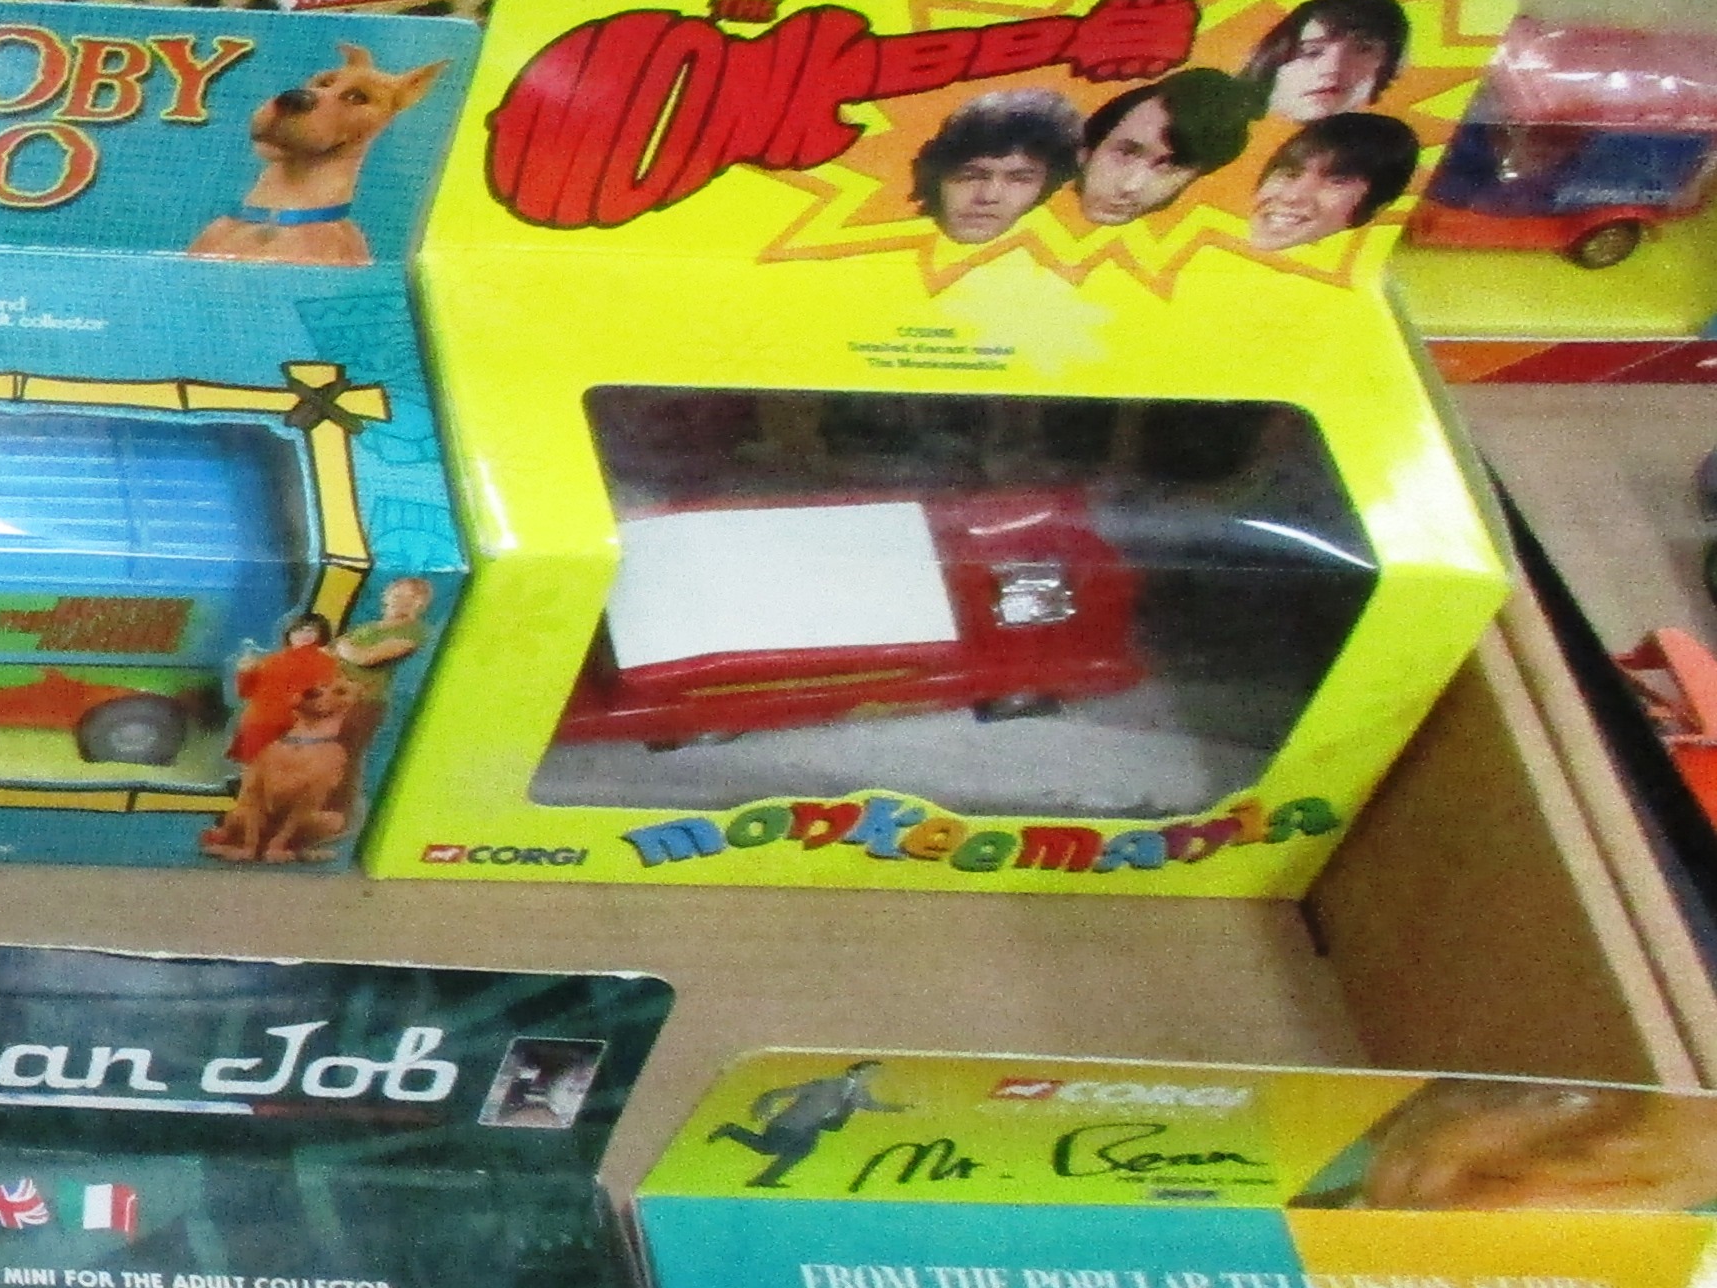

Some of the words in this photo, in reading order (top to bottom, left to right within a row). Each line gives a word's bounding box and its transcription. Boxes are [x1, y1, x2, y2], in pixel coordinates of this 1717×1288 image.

[465, 844, 588, 867] CORGI
[205, 1020, 458, 1103] Job
[1056, 1081, 1253, 1107] CORGI
[3, 1264, 57, 1288] MINI
